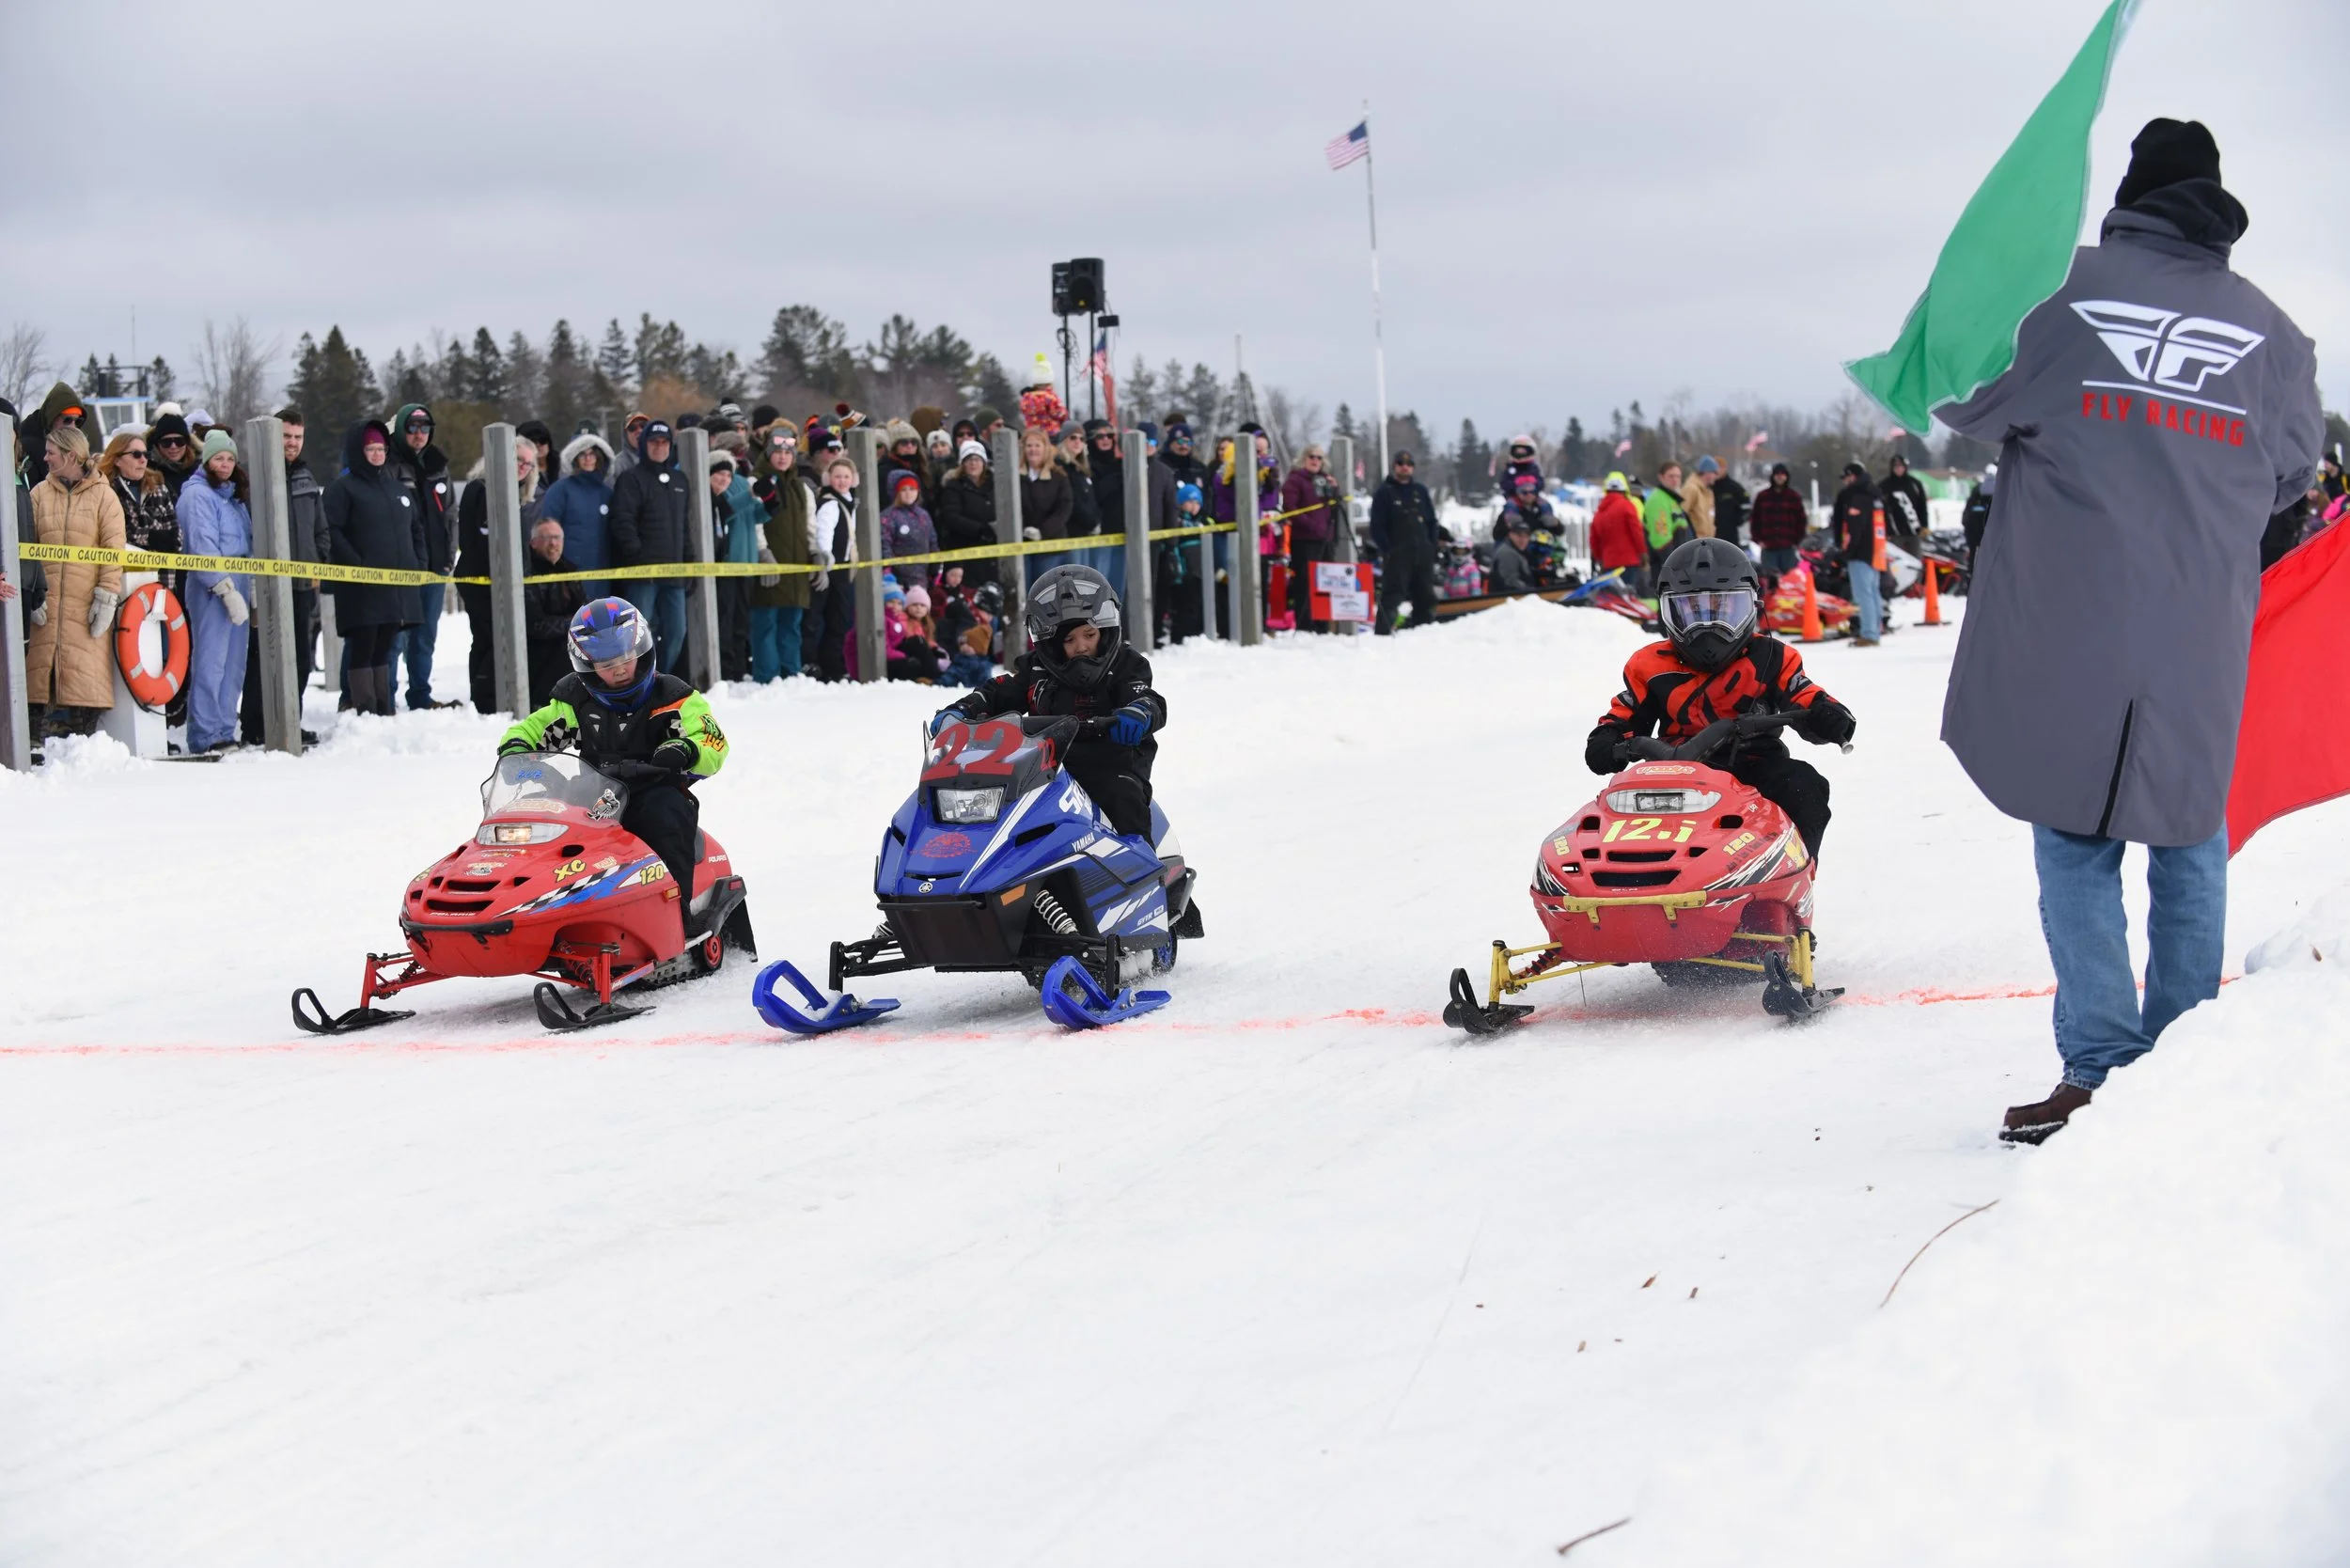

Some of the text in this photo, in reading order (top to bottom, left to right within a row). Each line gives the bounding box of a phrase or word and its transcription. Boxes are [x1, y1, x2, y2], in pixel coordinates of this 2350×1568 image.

[2081, 391, 2246, 447] FLY RACING
[28, 545, 70, 560] CAUTION
[77, 548, 120, 563] CAUTION
[126, 552, 168, 566] CAUTION
[175, 556, 217, 570] CAUTION
[224, 559, 266, 572] CAUTION
[273, 562, 307, 575] CAUTION
[312, 565, 346, 578] CAUTION
[351, 568, 384, 581] CAUTION
[388, 571, 422, 583] CAUTION
[919, 720, 1024, 782] 22
[1072, 832, 1096, 853] YAMAHA
[1553, 835, 1571, 856] 120
[1723, 832, 1756, 855] 120
[708, 854, 728, 863] POLARIS
[553, 859, 587, 883] XC
[640, 864, 665, 886] 120
